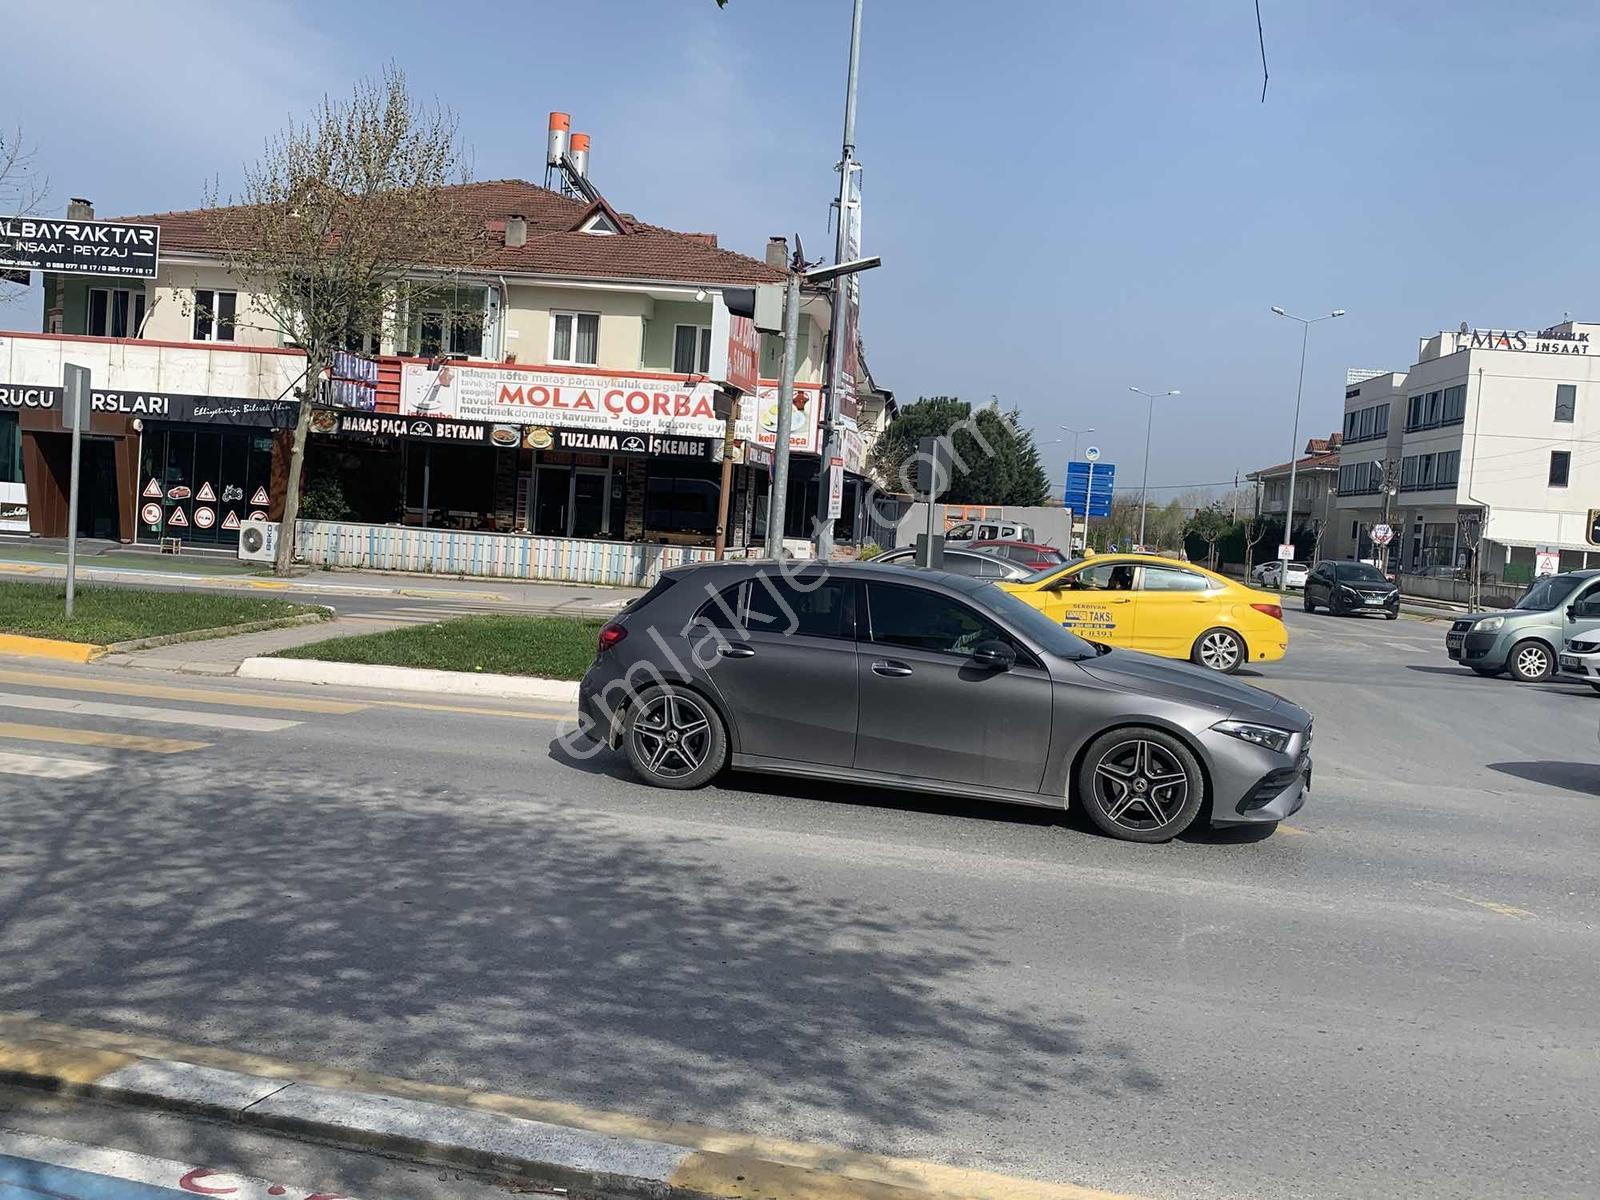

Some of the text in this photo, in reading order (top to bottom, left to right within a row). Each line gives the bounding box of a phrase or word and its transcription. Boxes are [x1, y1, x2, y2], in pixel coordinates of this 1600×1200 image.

[16, 239, 65, 254] İNŞAAT
[73, 244, 128, 257] PEYZAJ
[1470, 329, 1527, 351] MAS
[91, 393, 169, 415] RSLARI
[499, 384, 595, 411] MOLA
[604, 389, 714, 419] ÇORBA
[460, 405, 513, 417] mercimek
[514, 408, 560, 420] domates
[562, 411, 608, 423] kavurma
[342, 416, 484, 440] MARAŞ PAÇA BEYRAN
[560, 432, 705, 456] TUZLAMA İŞKEMBE
[758, 434, 776, 443] kell
[789, 437, 807, 446] aça
